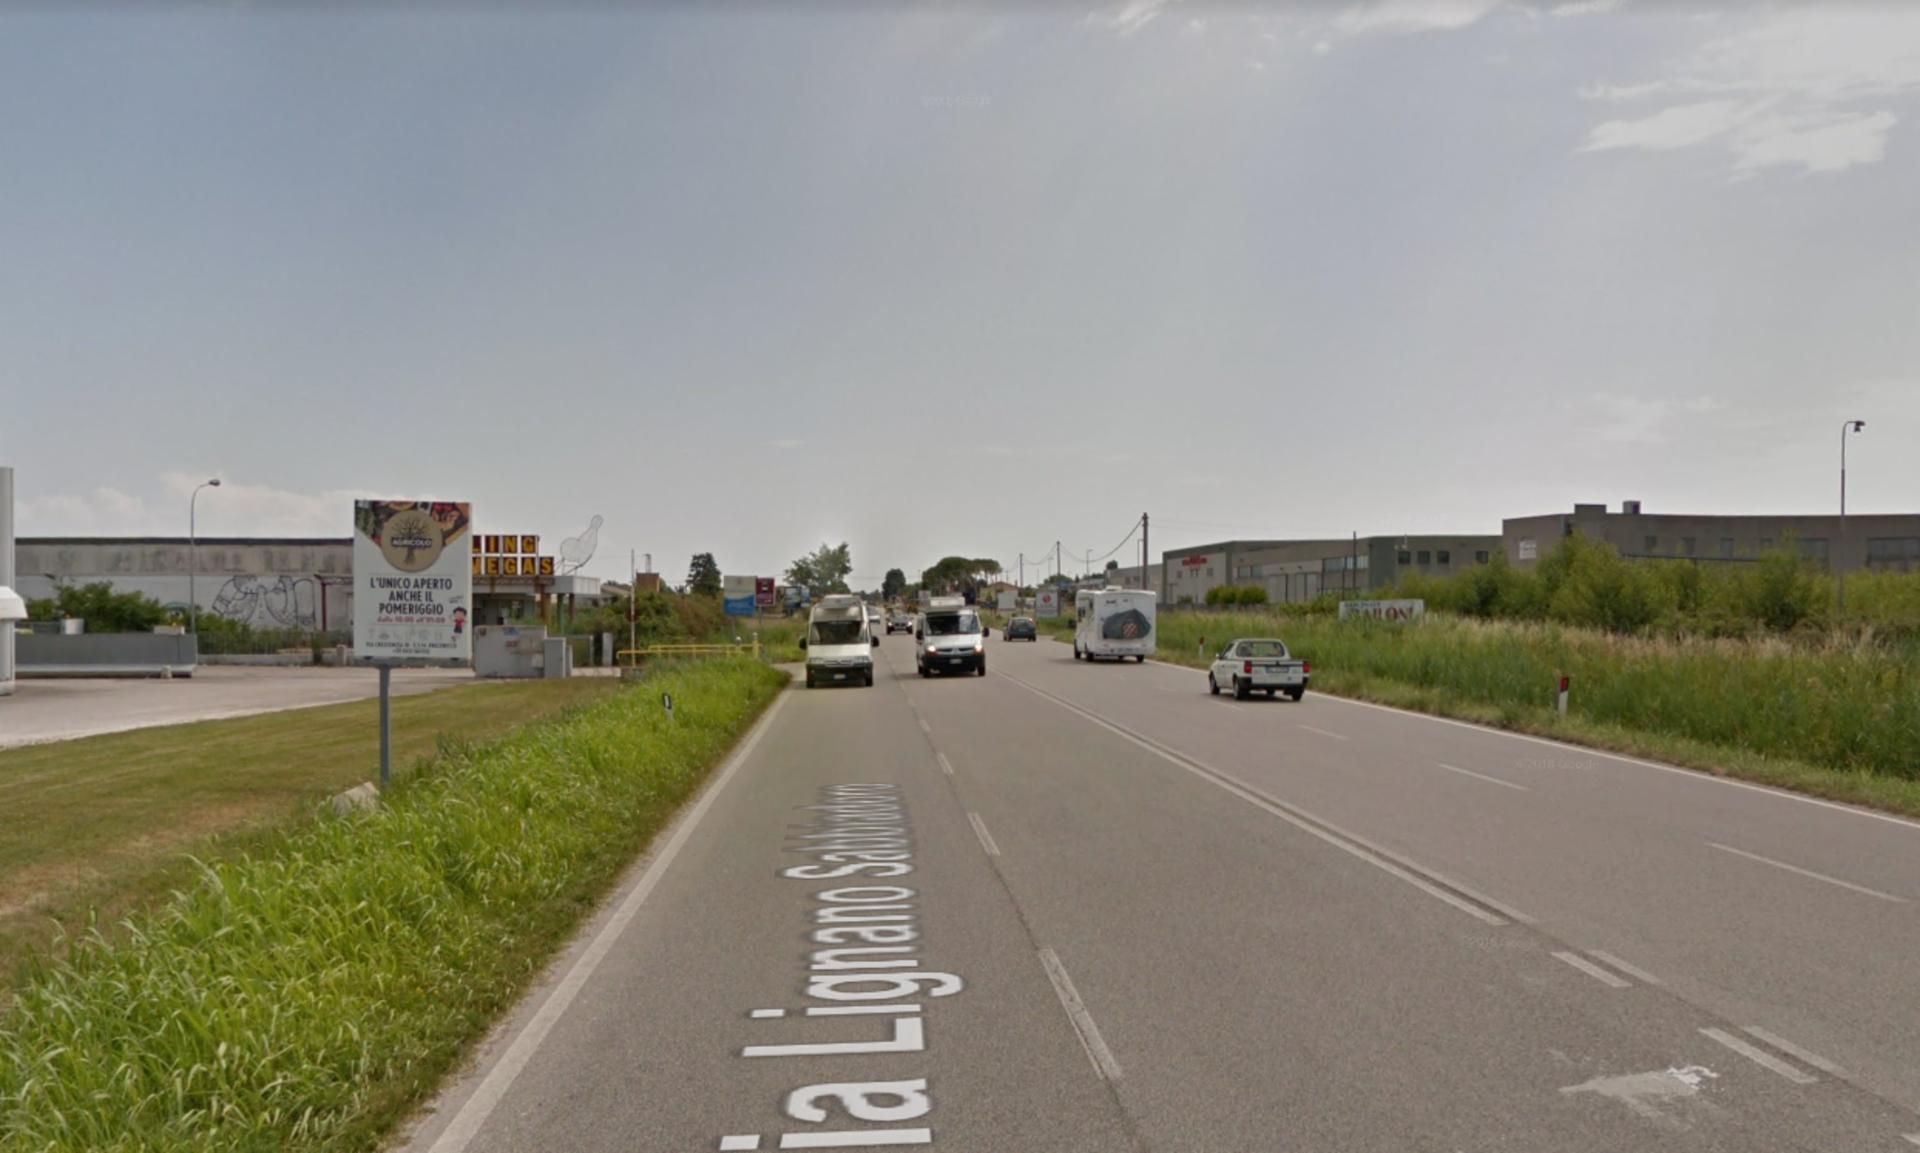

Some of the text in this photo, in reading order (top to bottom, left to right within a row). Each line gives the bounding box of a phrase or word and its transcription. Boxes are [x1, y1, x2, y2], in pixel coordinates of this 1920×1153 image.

[370, 577, 452, 590] L'UNICO APERTO
[388, 590, 434, 602] ANCHE IL
[379, 603, 444, 615] POMERIGGIO
